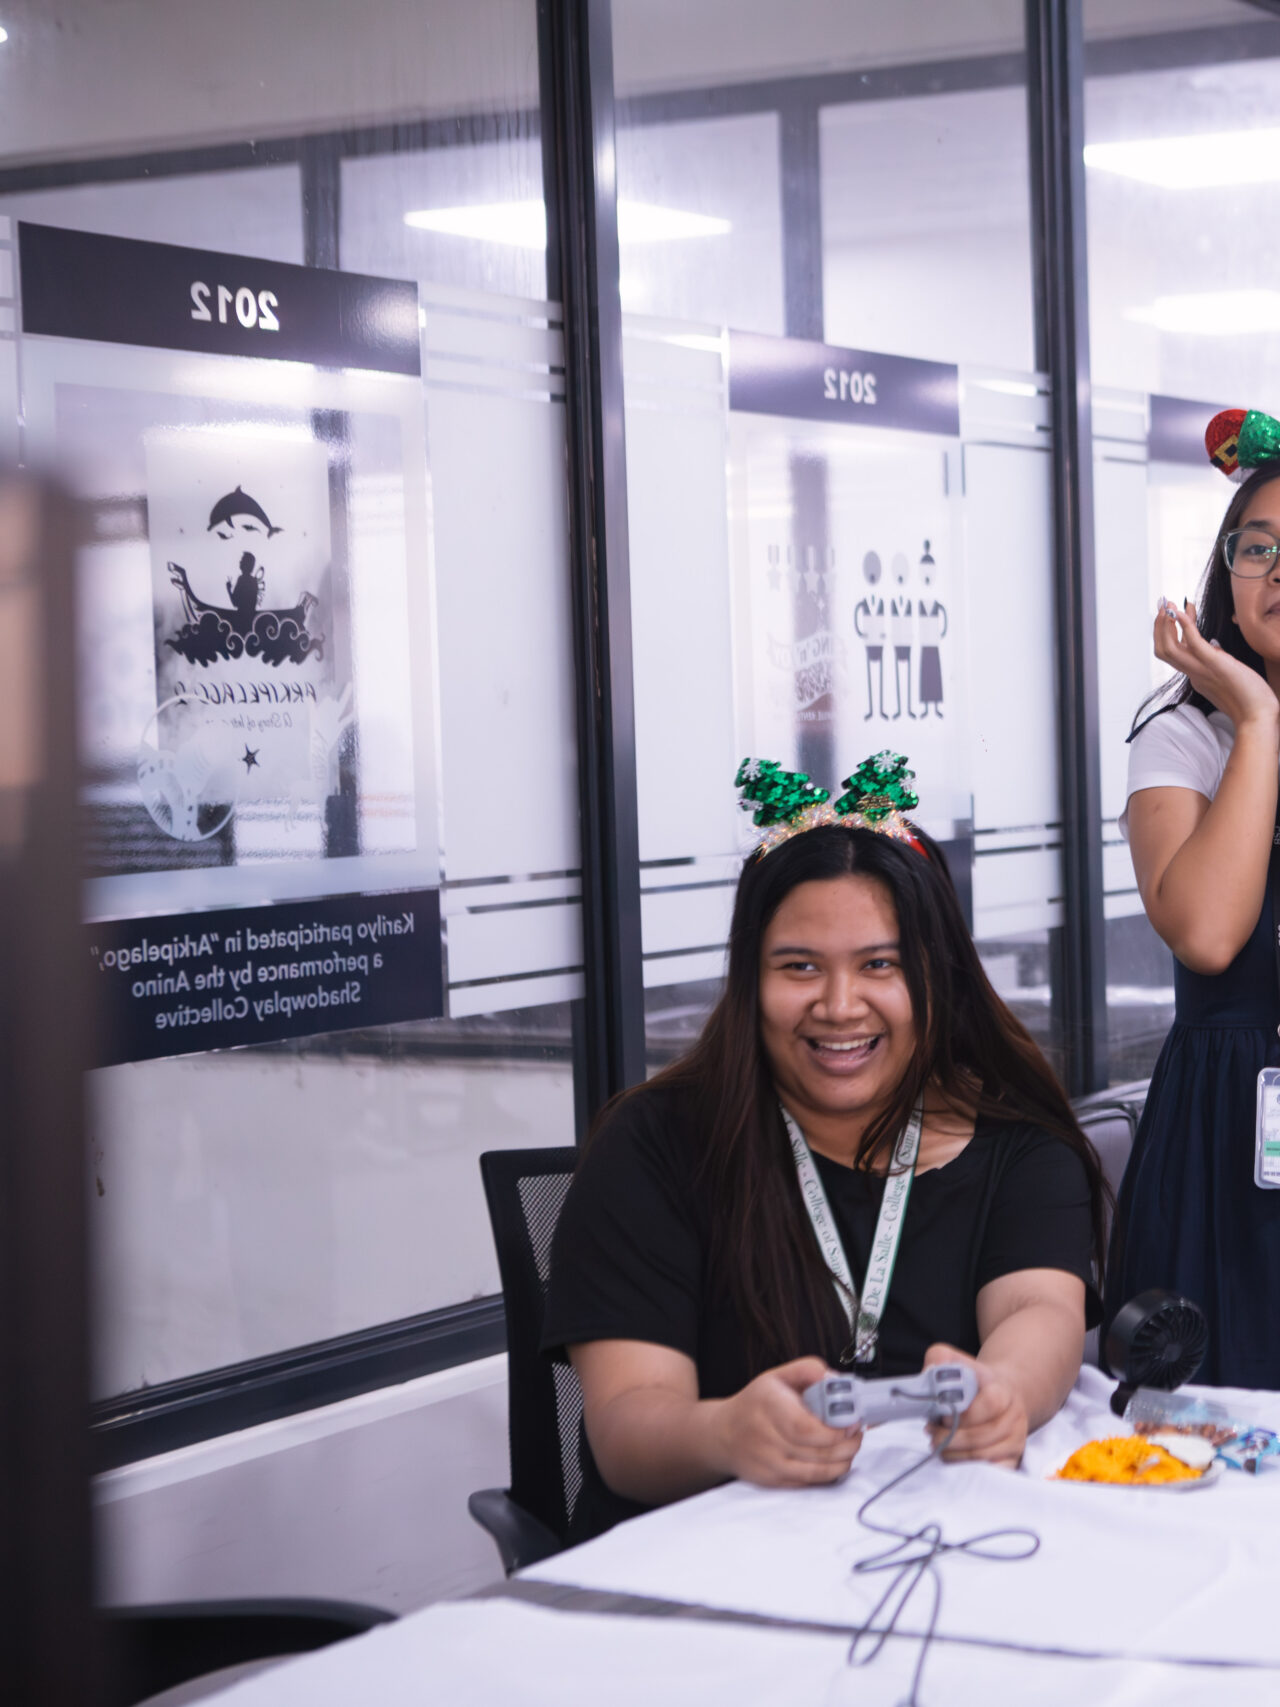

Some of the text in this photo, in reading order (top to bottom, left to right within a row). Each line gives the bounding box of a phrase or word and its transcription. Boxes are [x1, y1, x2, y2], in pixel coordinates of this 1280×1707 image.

[804, 1179, 825, 1226] College
[882, 1177, 906, 1222] College
[875, 1233, 893, 1264] Salle
[870, 1267, 886, 1285] La
[864, 1289, 879, 1309] De
